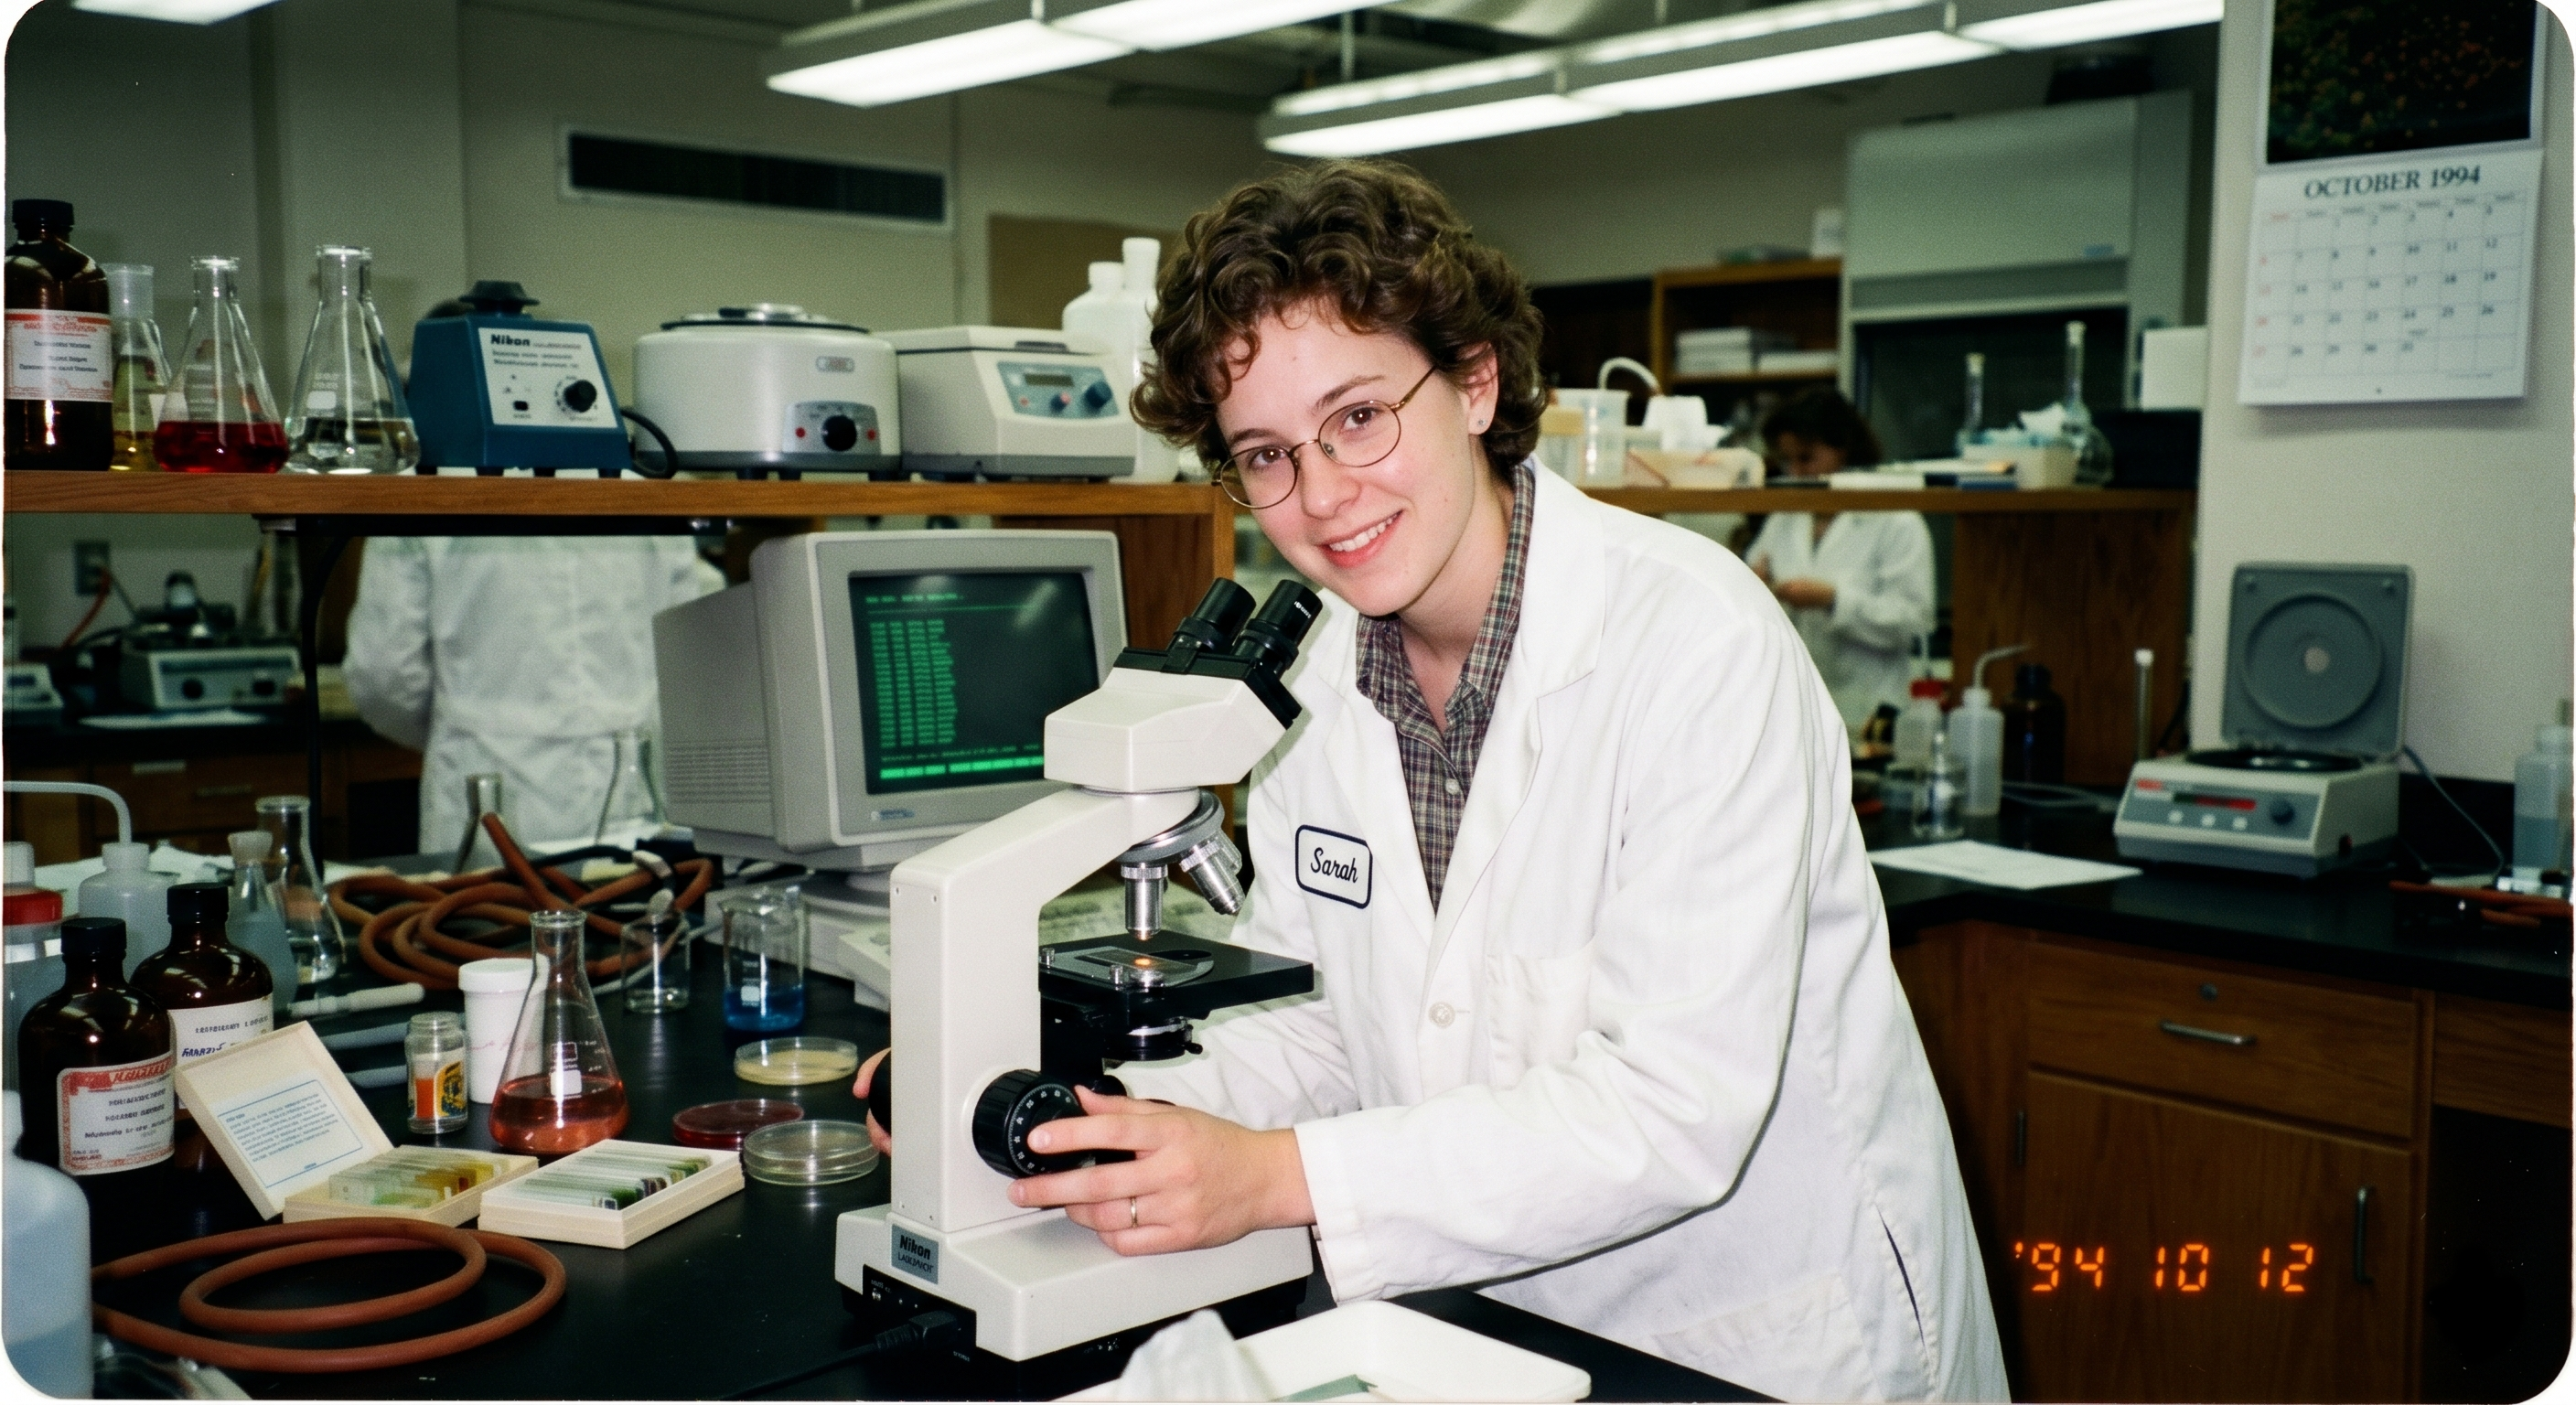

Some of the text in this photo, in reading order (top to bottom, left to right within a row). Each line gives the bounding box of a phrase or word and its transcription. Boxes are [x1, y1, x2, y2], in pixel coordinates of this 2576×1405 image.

[2304, 165, 2481, 198] OCTOBER 1994
[1311, 847, 1358, 884] Sarah
[899, 1234, 931, 1260] Nikon
